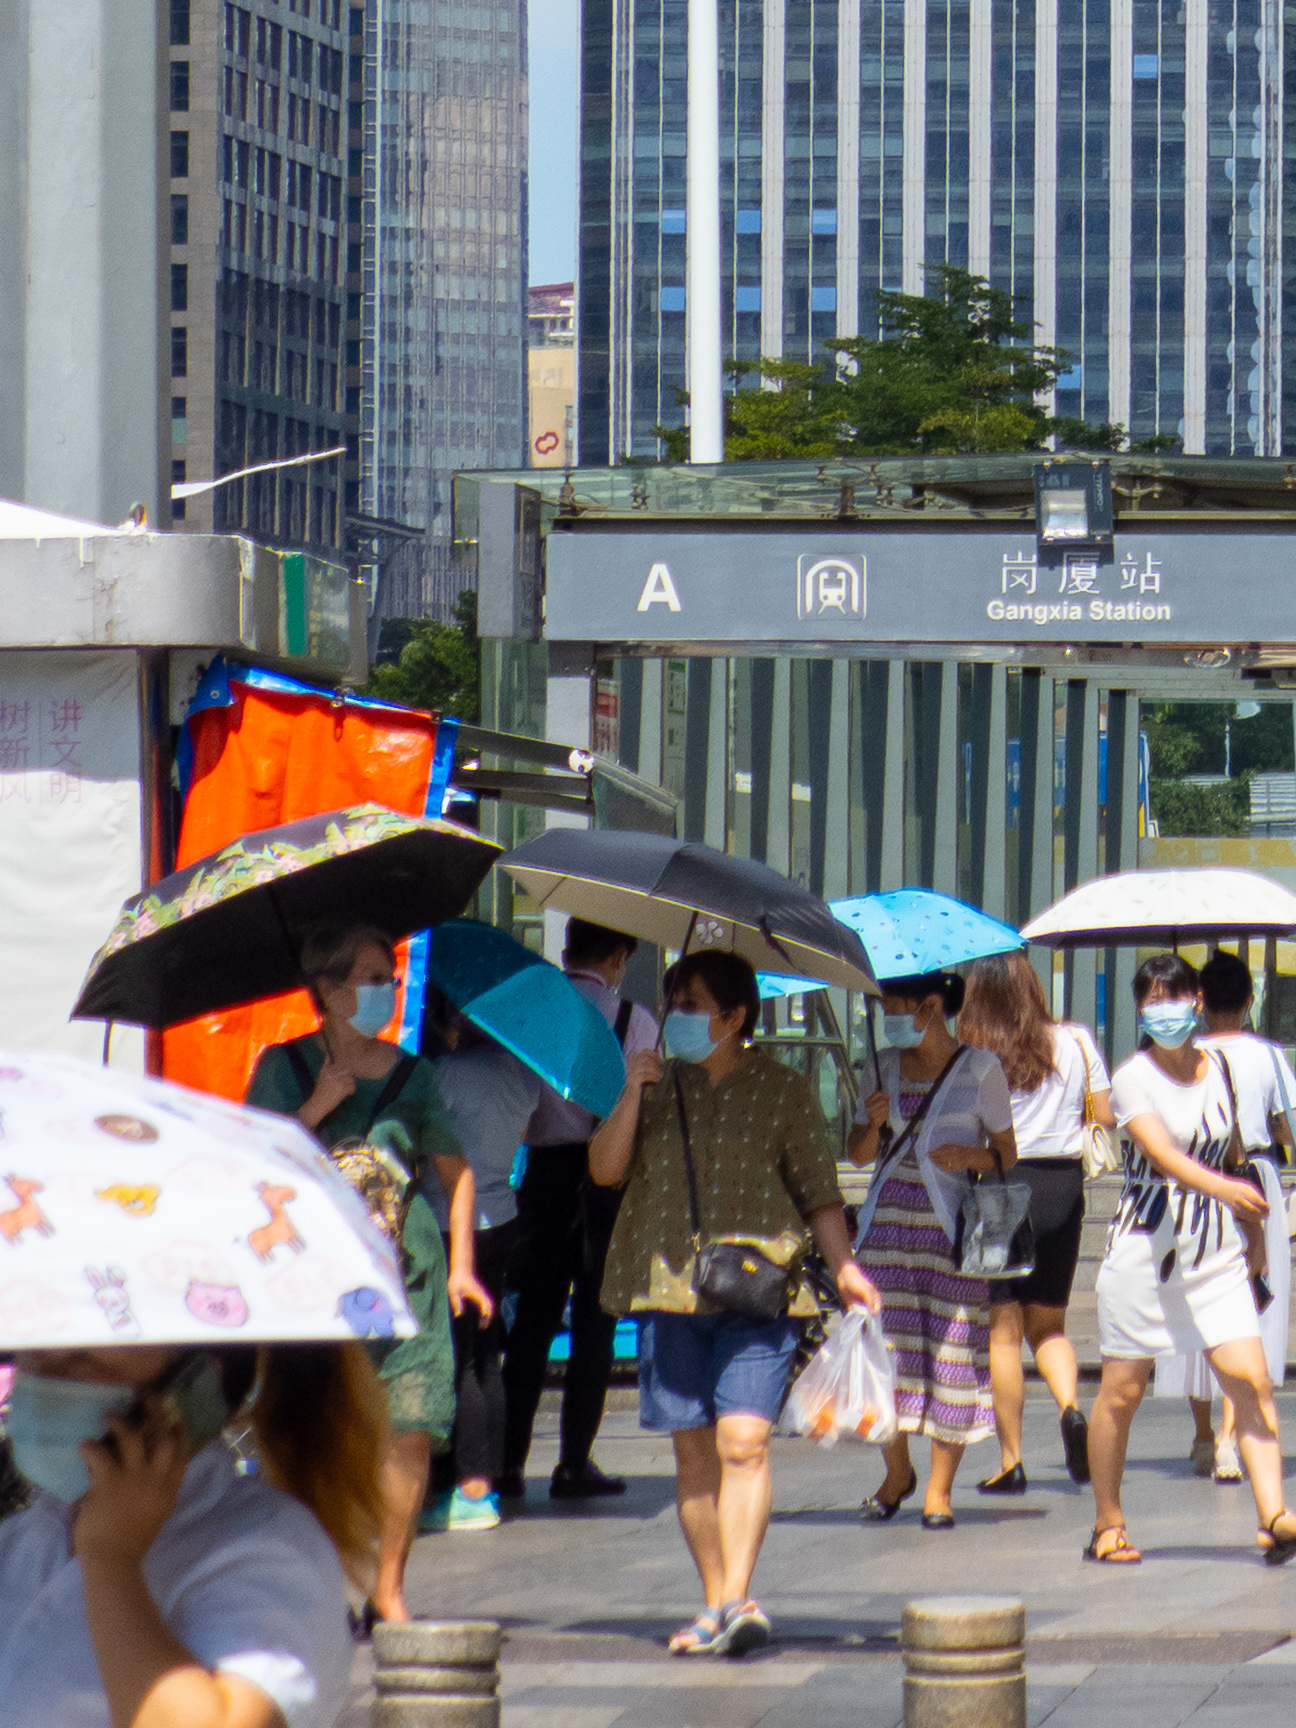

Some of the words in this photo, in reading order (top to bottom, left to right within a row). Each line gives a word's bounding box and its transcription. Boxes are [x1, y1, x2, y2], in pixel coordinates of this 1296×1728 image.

[637, 562, 682, 612] A
[1001, 550, 1162, 595] 岗厦站
[986, 600, 1082, 625] Gangxia
[1089, 600, 1172, 621] Station
[48, 698, 83, 805] 讲文明
